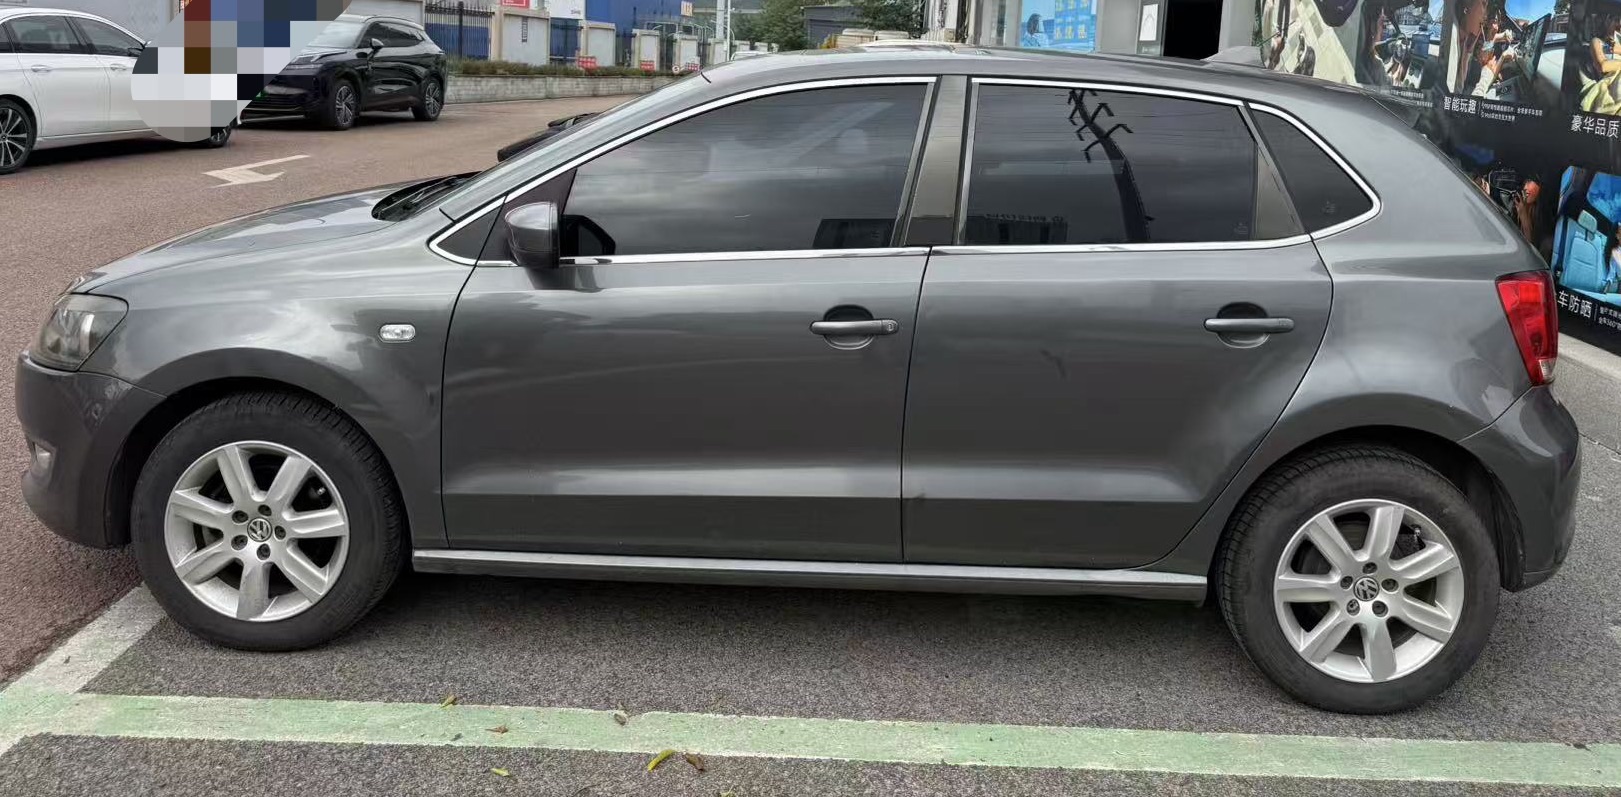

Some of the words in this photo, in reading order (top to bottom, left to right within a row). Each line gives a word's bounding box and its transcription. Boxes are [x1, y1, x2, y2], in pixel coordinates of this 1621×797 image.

[1443, 96, 1477, 114] 智能玩趣
[1570, 114, 1620, 138] 豪华品质
